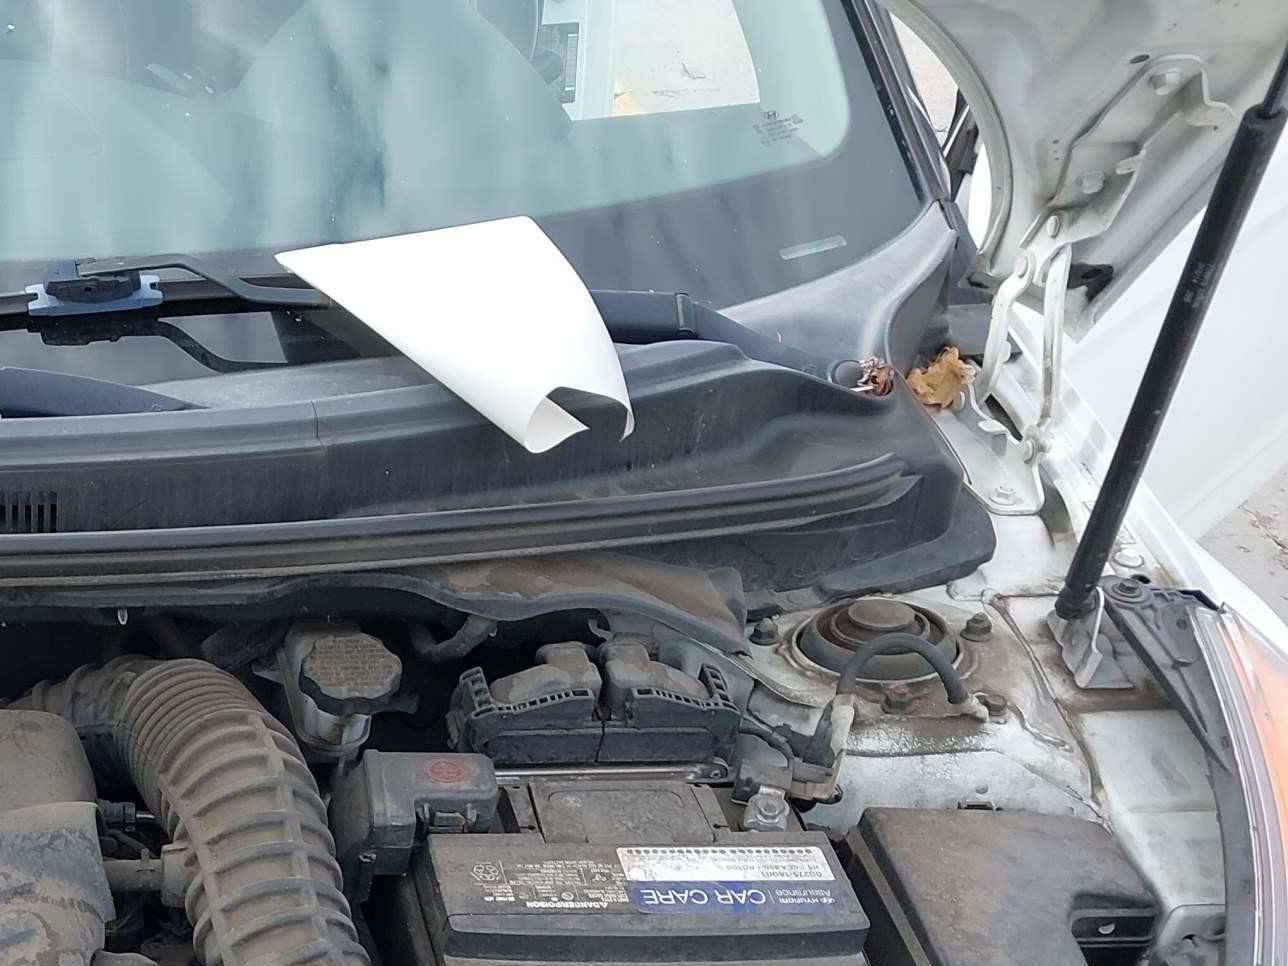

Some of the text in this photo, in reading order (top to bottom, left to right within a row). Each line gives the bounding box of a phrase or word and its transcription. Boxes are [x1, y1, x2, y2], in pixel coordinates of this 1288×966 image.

[640, 888, 709, 905] CARE
[713, 888, 766, 905] CAR
[775, 888, 831, 897] Assurance
